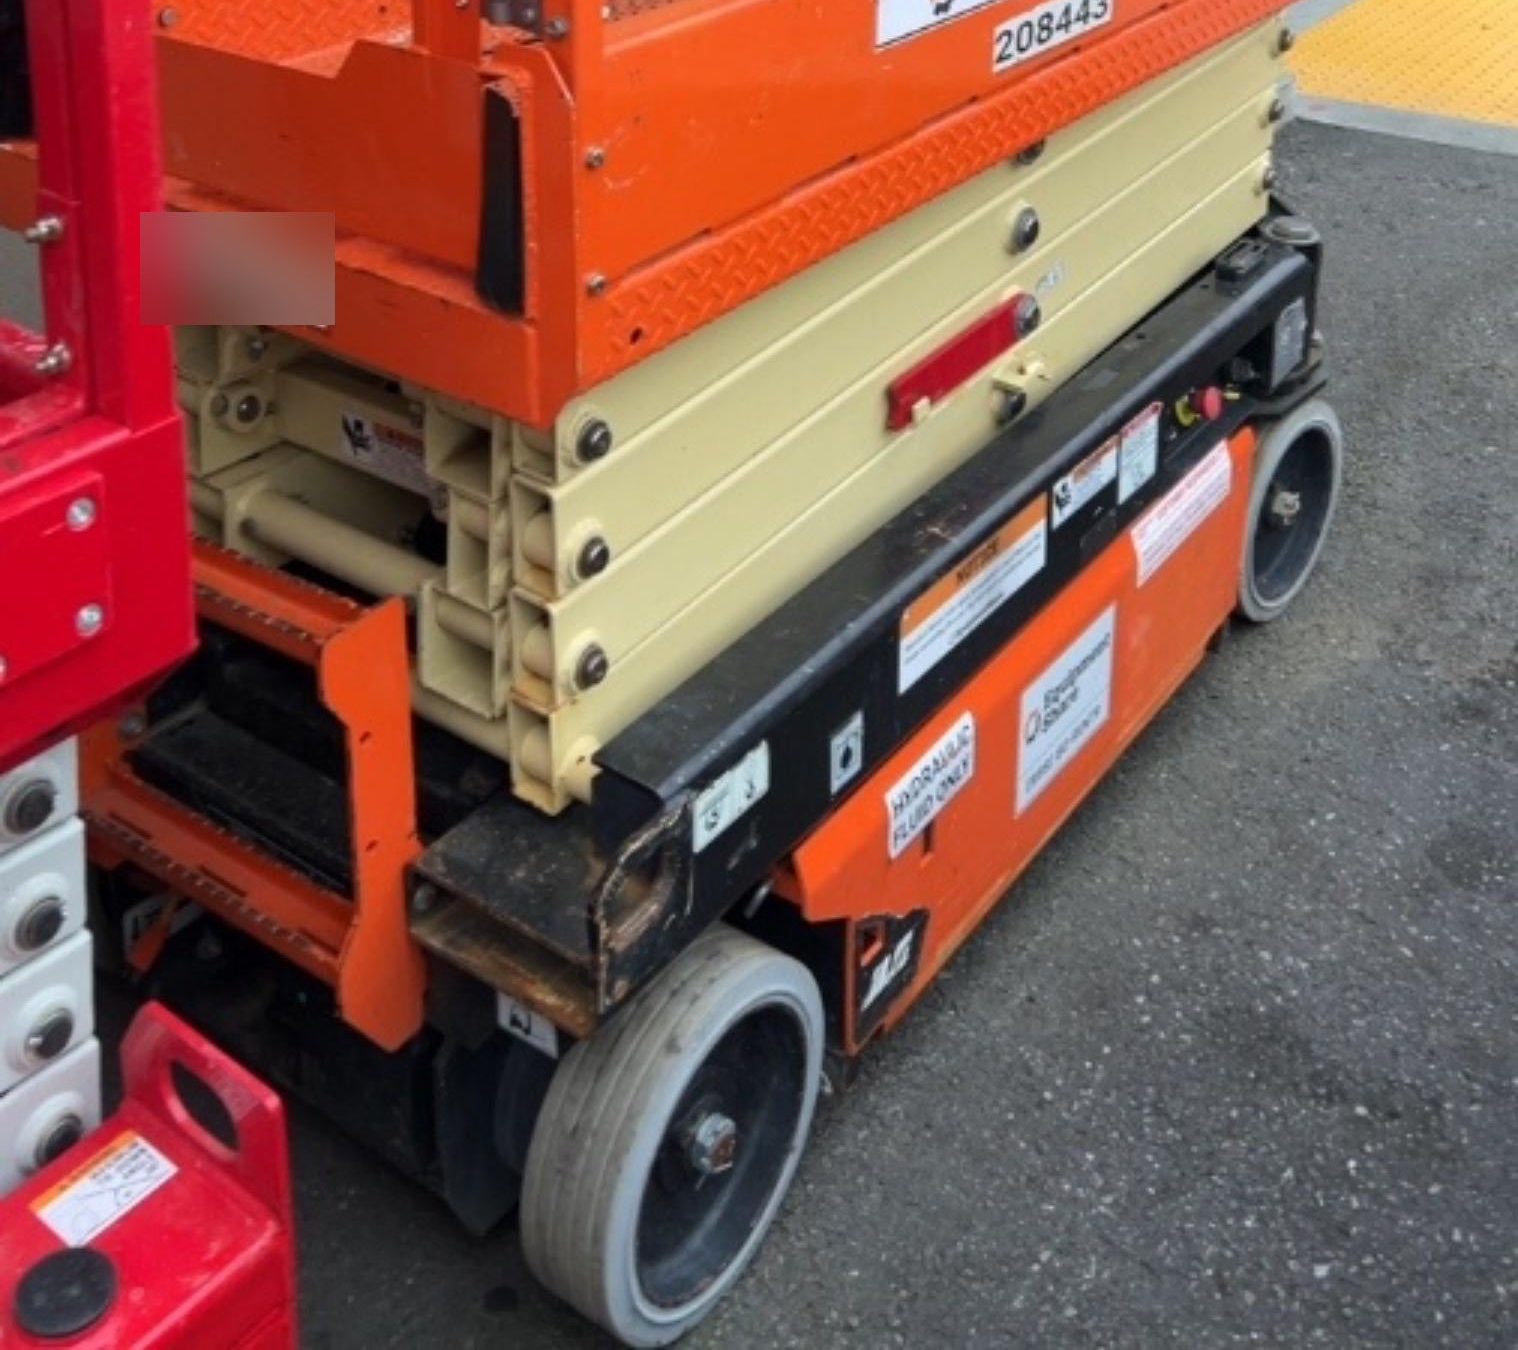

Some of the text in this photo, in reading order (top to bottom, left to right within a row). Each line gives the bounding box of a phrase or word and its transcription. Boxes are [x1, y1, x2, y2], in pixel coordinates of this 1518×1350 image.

[893, 723, 971, 819] HYDRAULIC
[893, 758, 969, 851] FLUID ONLY
